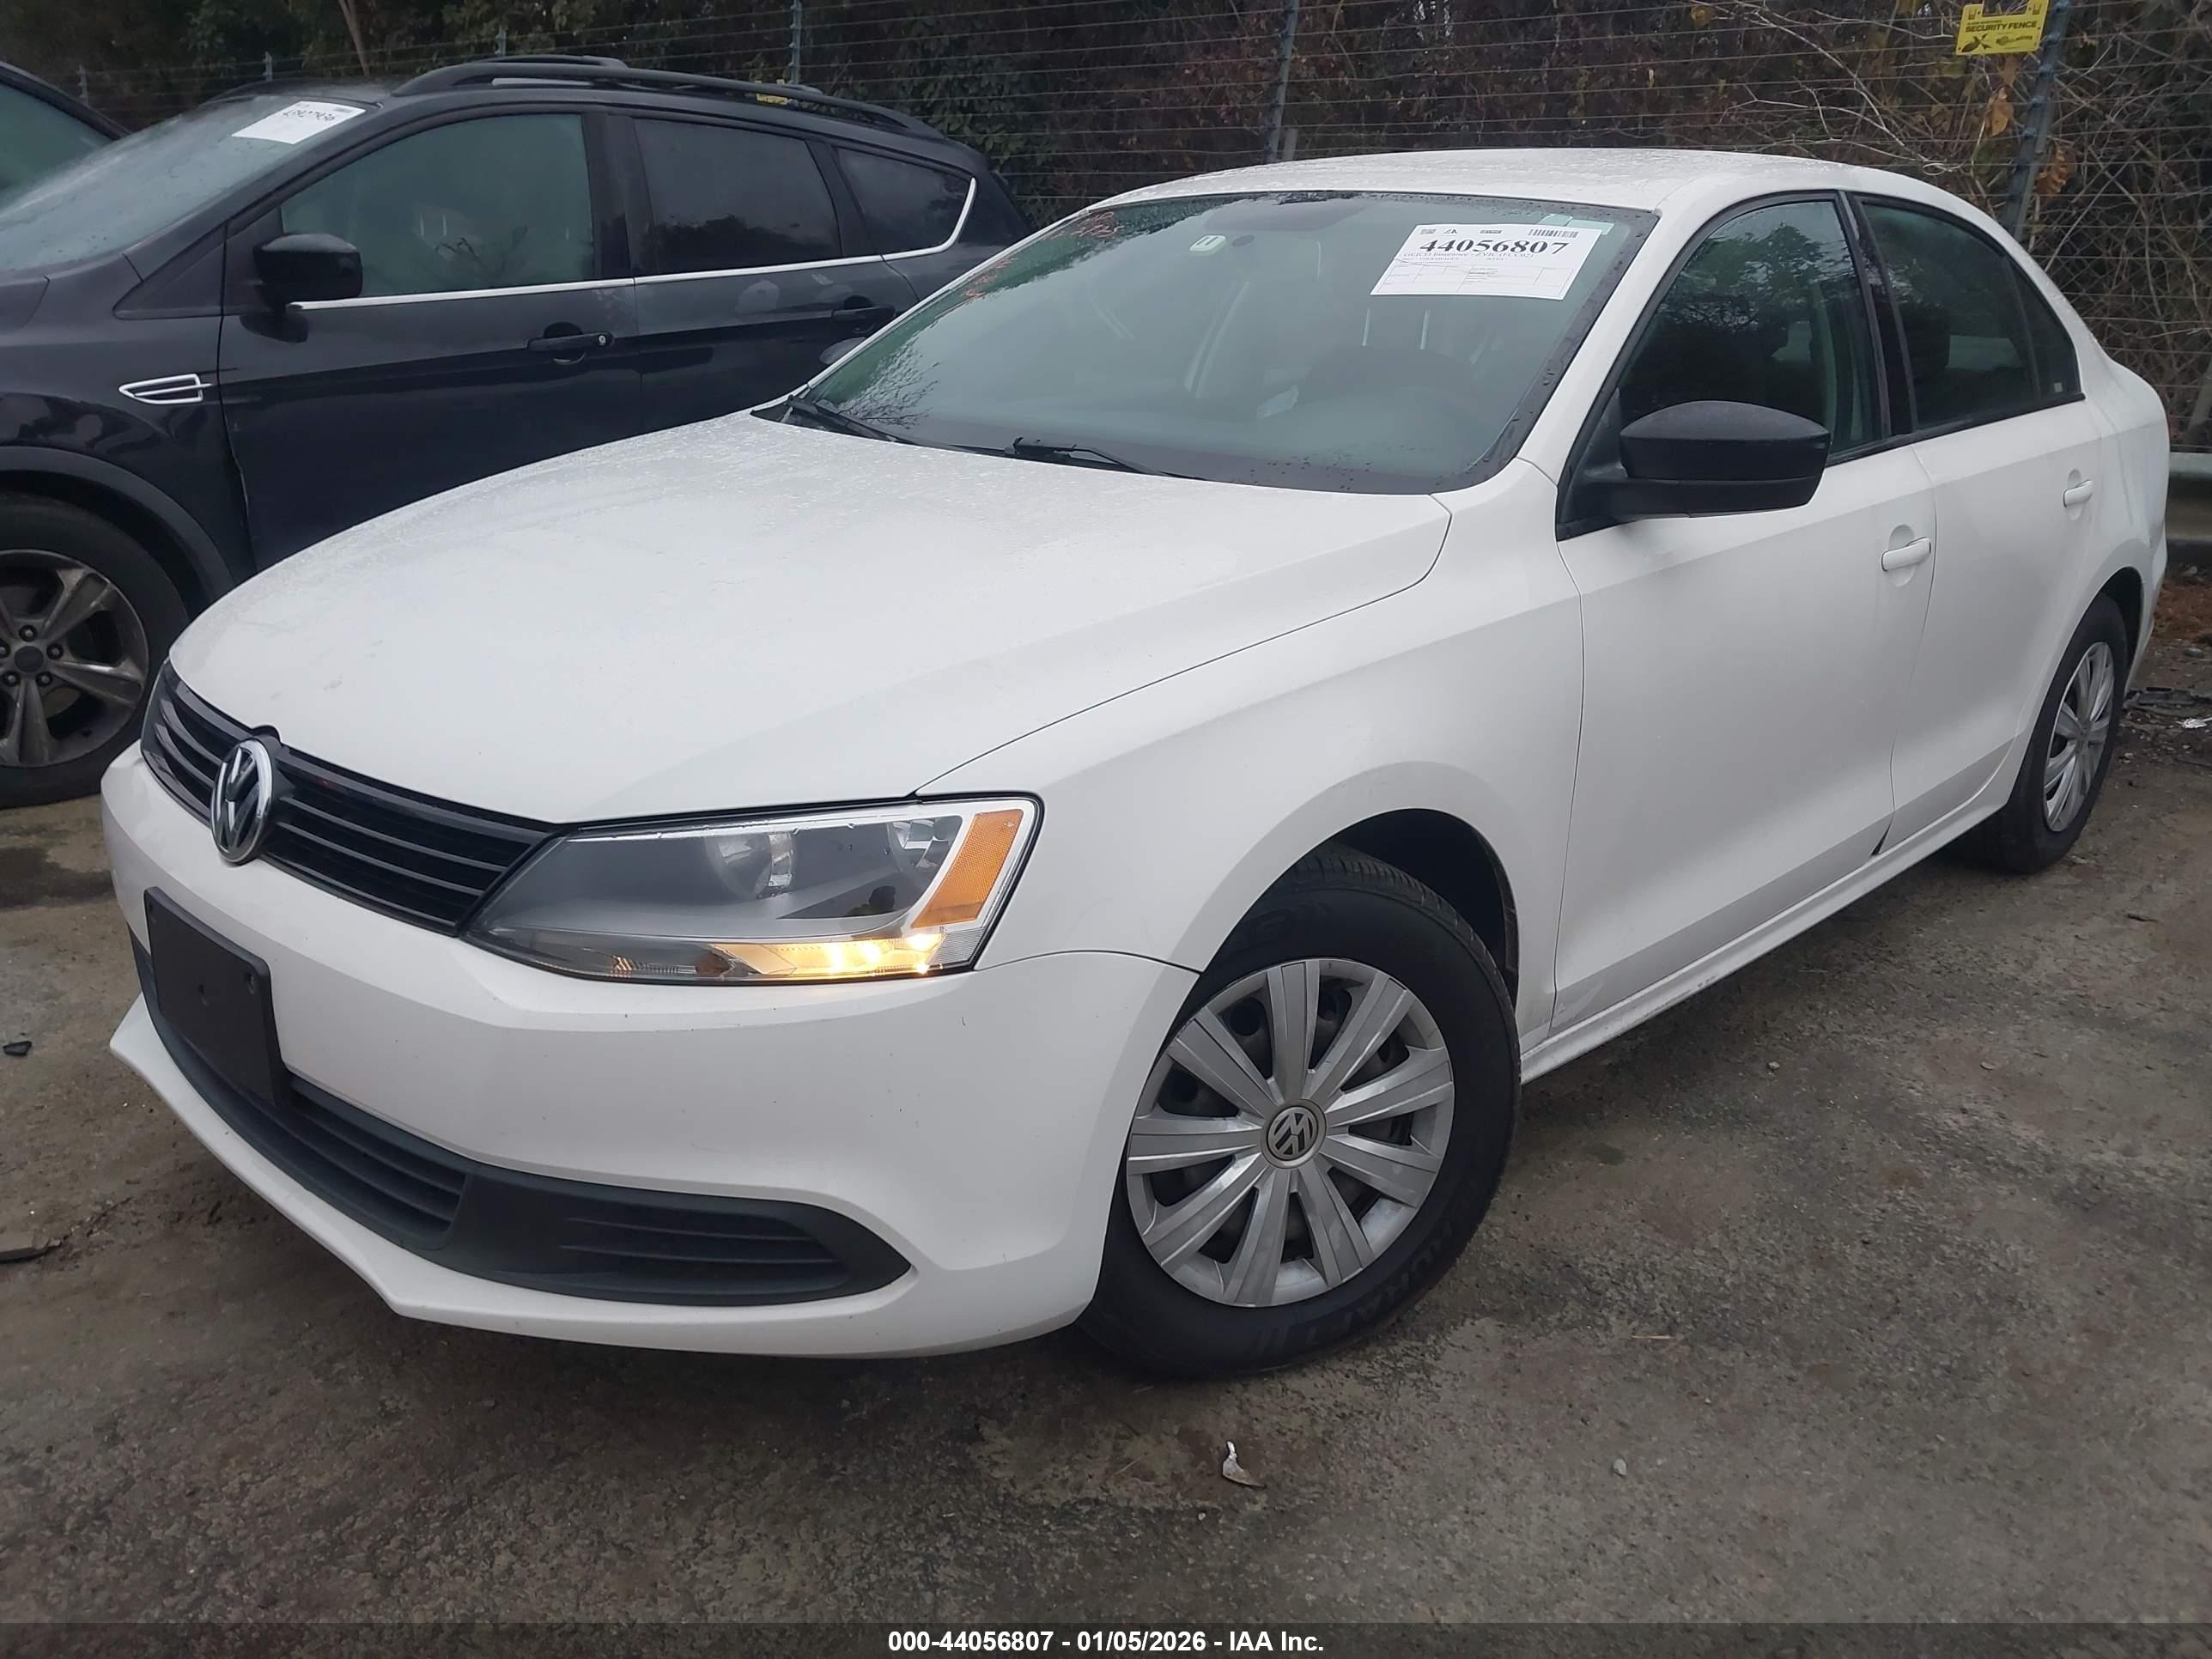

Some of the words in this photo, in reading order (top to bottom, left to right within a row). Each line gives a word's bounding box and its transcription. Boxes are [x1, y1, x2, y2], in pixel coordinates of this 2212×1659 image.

[1966, 23, 2008, 33] SECURITY
[2008, 21, 2038, 29] FENCE
[1419, 240, 1570, 254] 44056807
